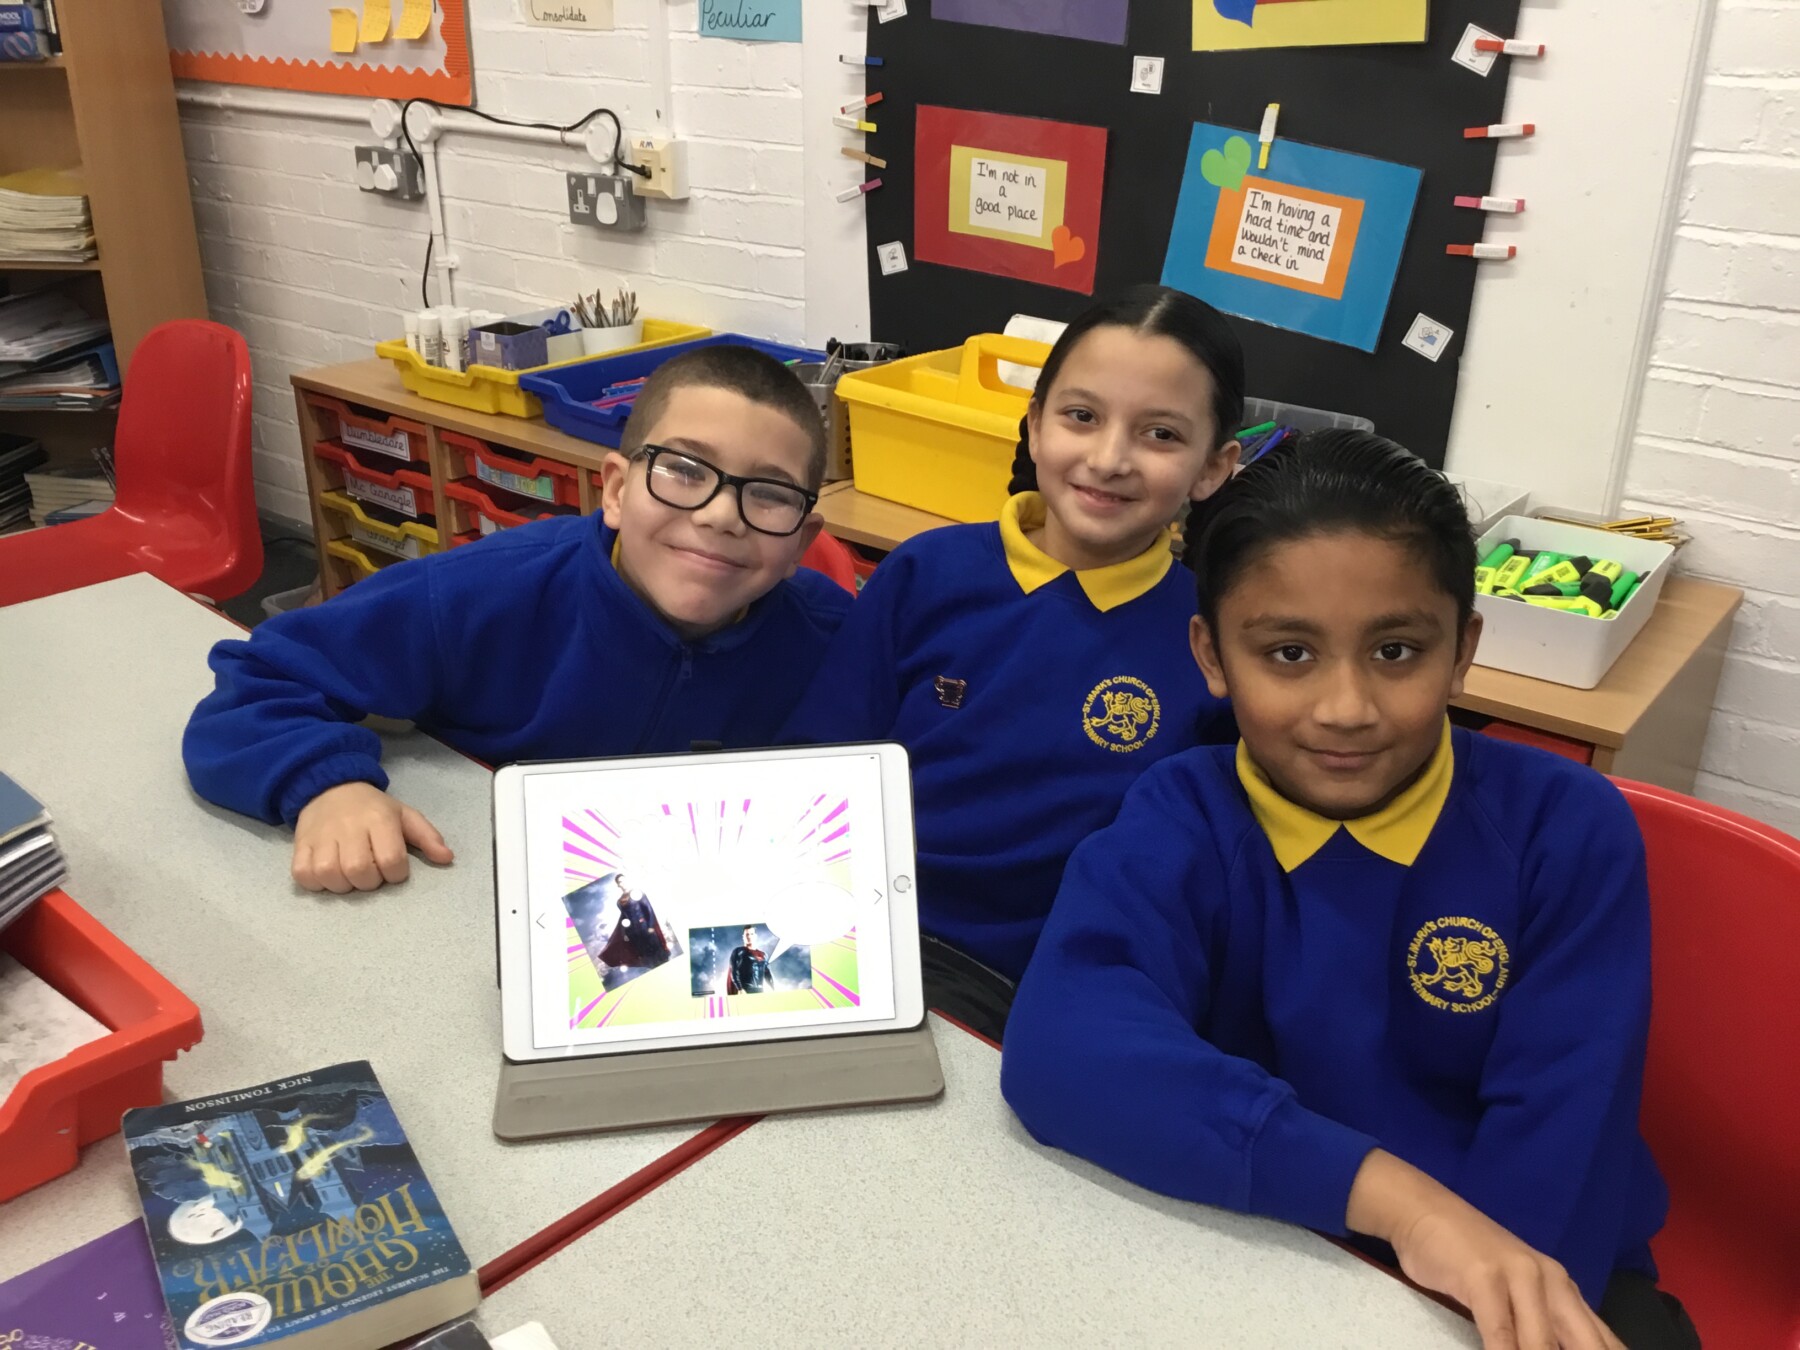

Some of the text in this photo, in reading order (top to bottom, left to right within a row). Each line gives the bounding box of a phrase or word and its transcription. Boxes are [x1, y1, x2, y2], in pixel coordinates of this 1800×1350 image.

[701, 0, 776, 31] Peculiar
[977, 162, 1037, 188] I'm not in
[998, 185, 1007, 198] a
[975, 197, 1038, 221] good place
[1249, 191, 1331, 232] I'm having a
[1244, 209, 1331, 247] hard time and
[1237, 245, 1246, 255] a
[1285, 255, 1299, 271] in
[1296, 243, 1325, 262] mind
[1112, 675, 1149, 691] CHURCH
[1110, 740, 1145, 753] SCHOOL
[1437, 916, 1484, 932] CHURCH
[1481, 926, 1499, 939] OF
[1491, 938, 1510, 989] ENGLAND
[1451, 994, 1498, 1013] SCHOOL
[184, 1075, 312, 1113] NICK TOMLINSON
[245, 1231, 419, 1318] GHOUL
[366, 1272, 394, 1289] THE
[266, 1266, 450, 1334] THE SCARIEST LEGENDS ARE ABOUT TO
[205, 1311, 254, 1332] READING
